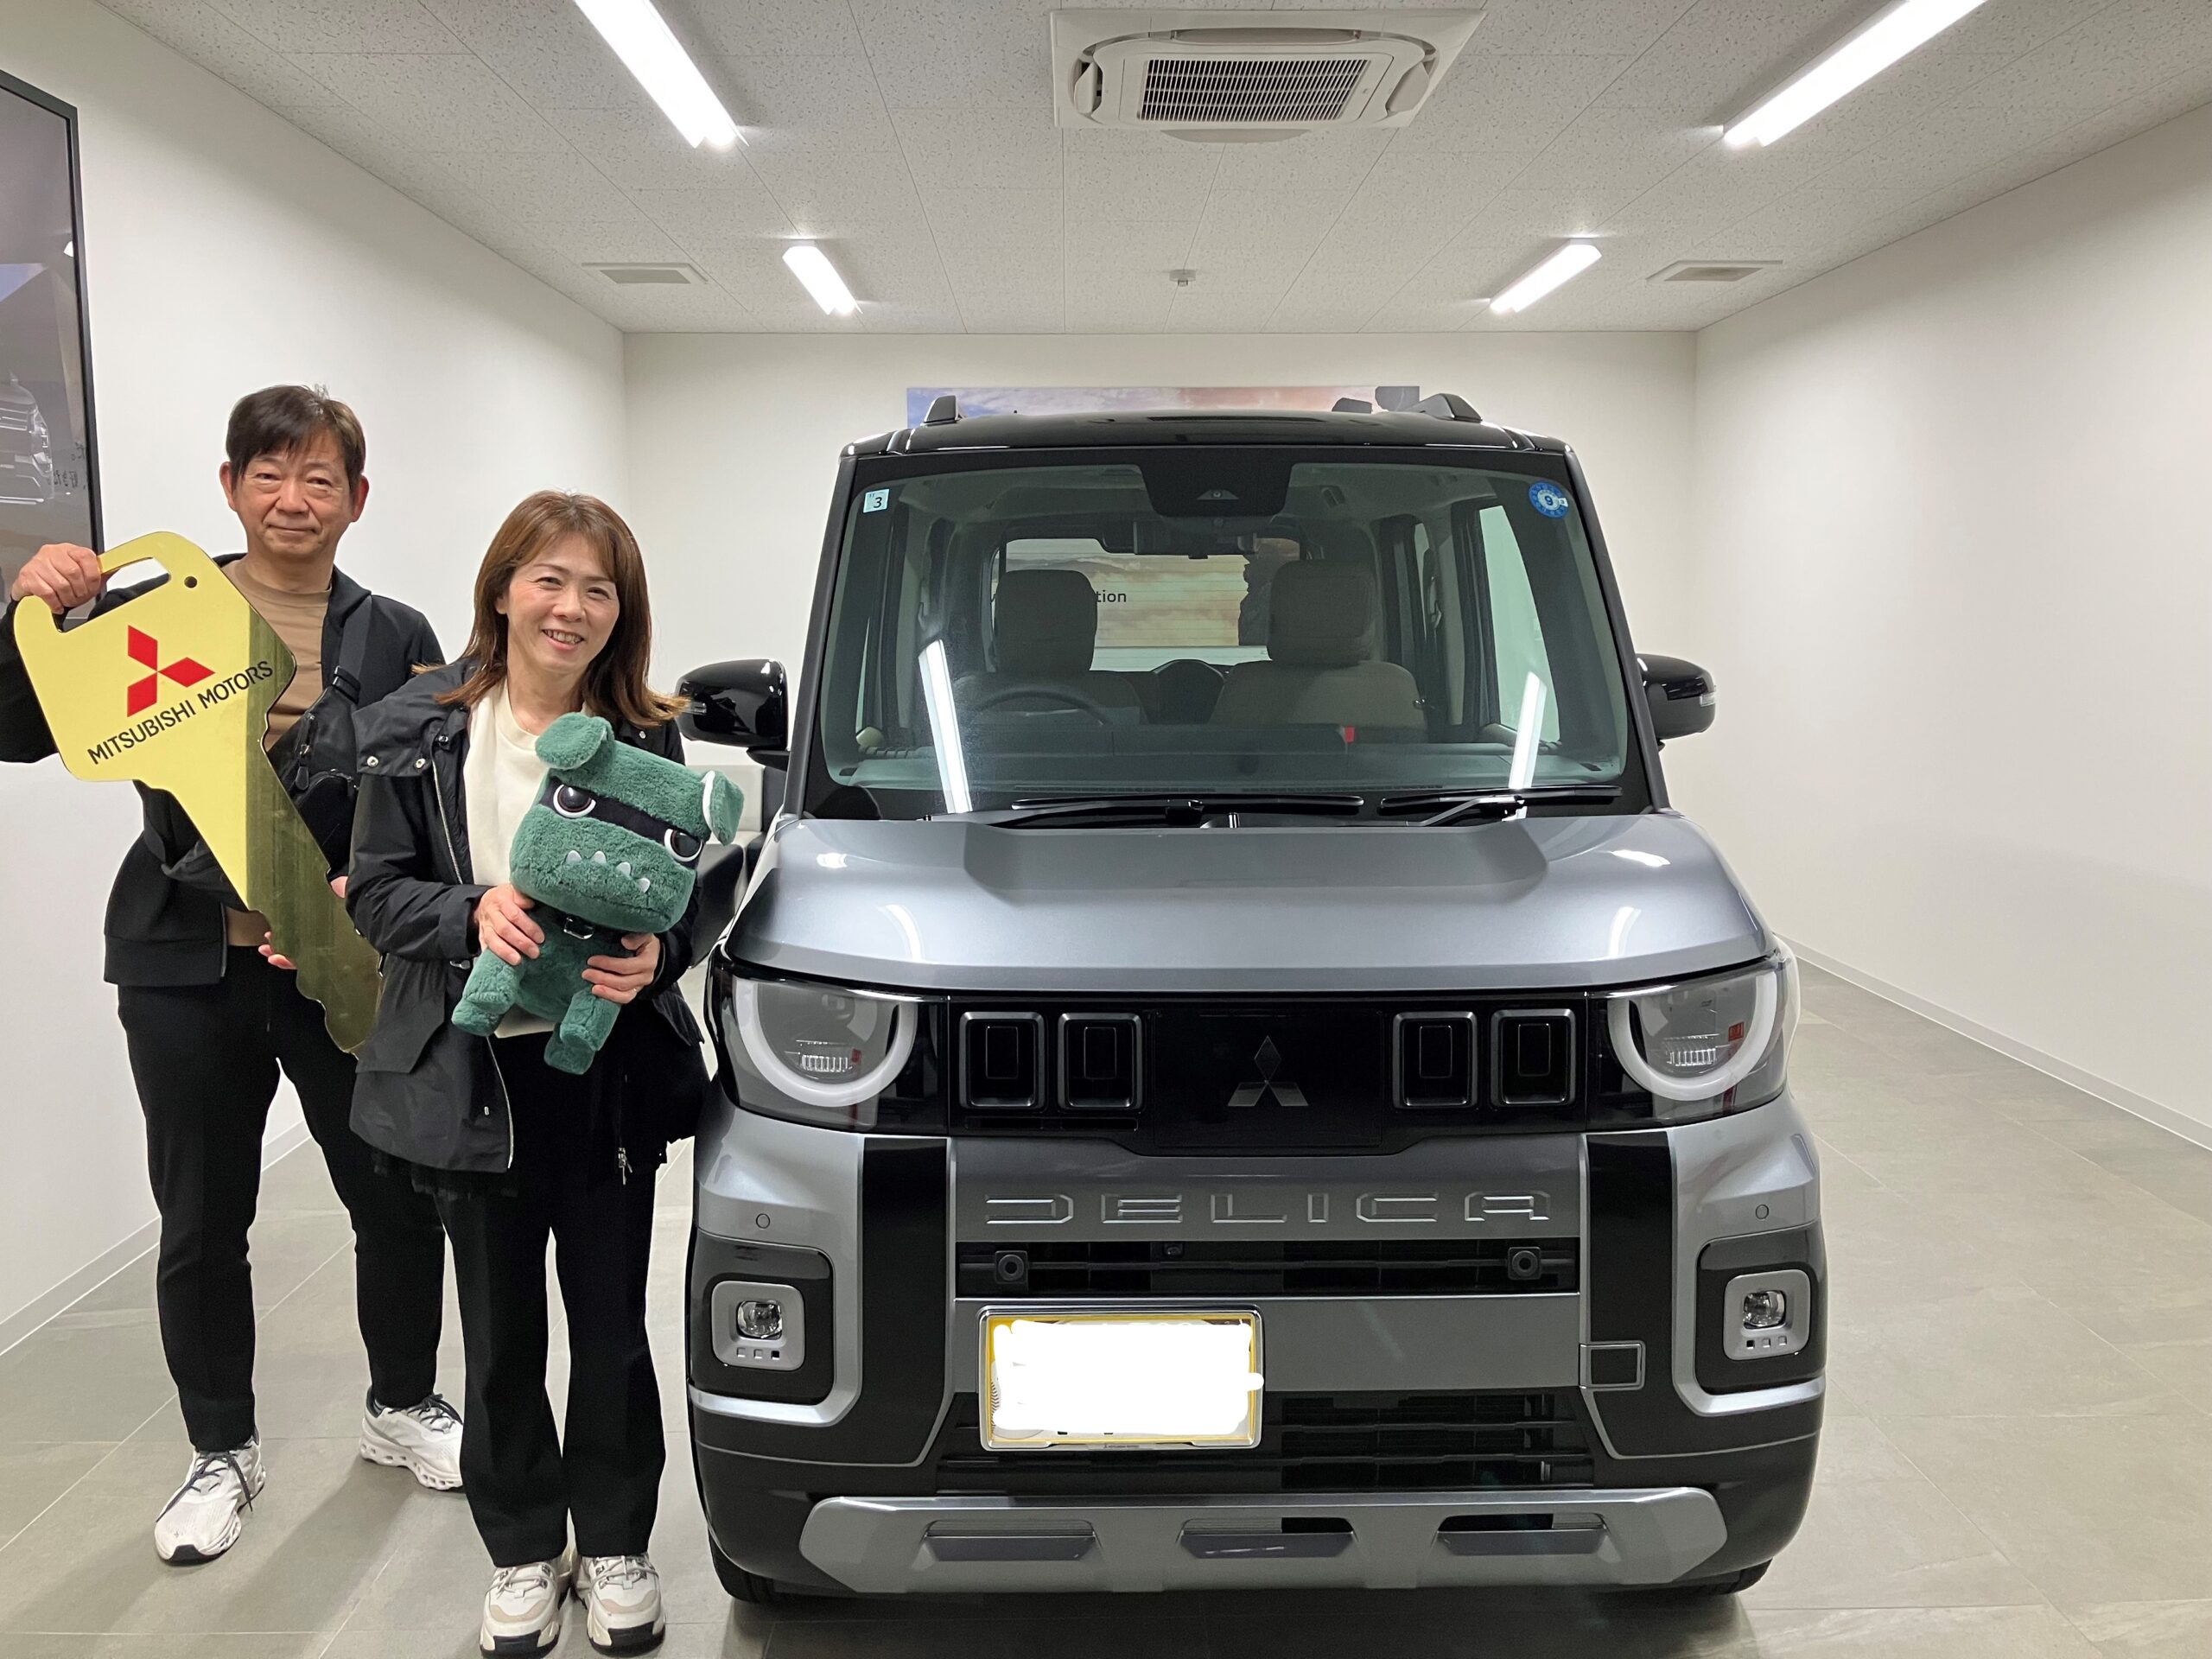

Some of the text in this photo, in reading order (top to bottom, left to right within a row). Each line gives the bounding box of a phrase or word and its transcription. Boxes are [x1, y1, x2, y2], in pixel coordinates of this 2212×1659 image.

[873, 496, 883, 509] 3
[1544, 495, 1554, 506] 9
[87, 660, 273, 766] MITSUBISHI MOTORS
[984, 1191, 1553, 1224] DELICA
